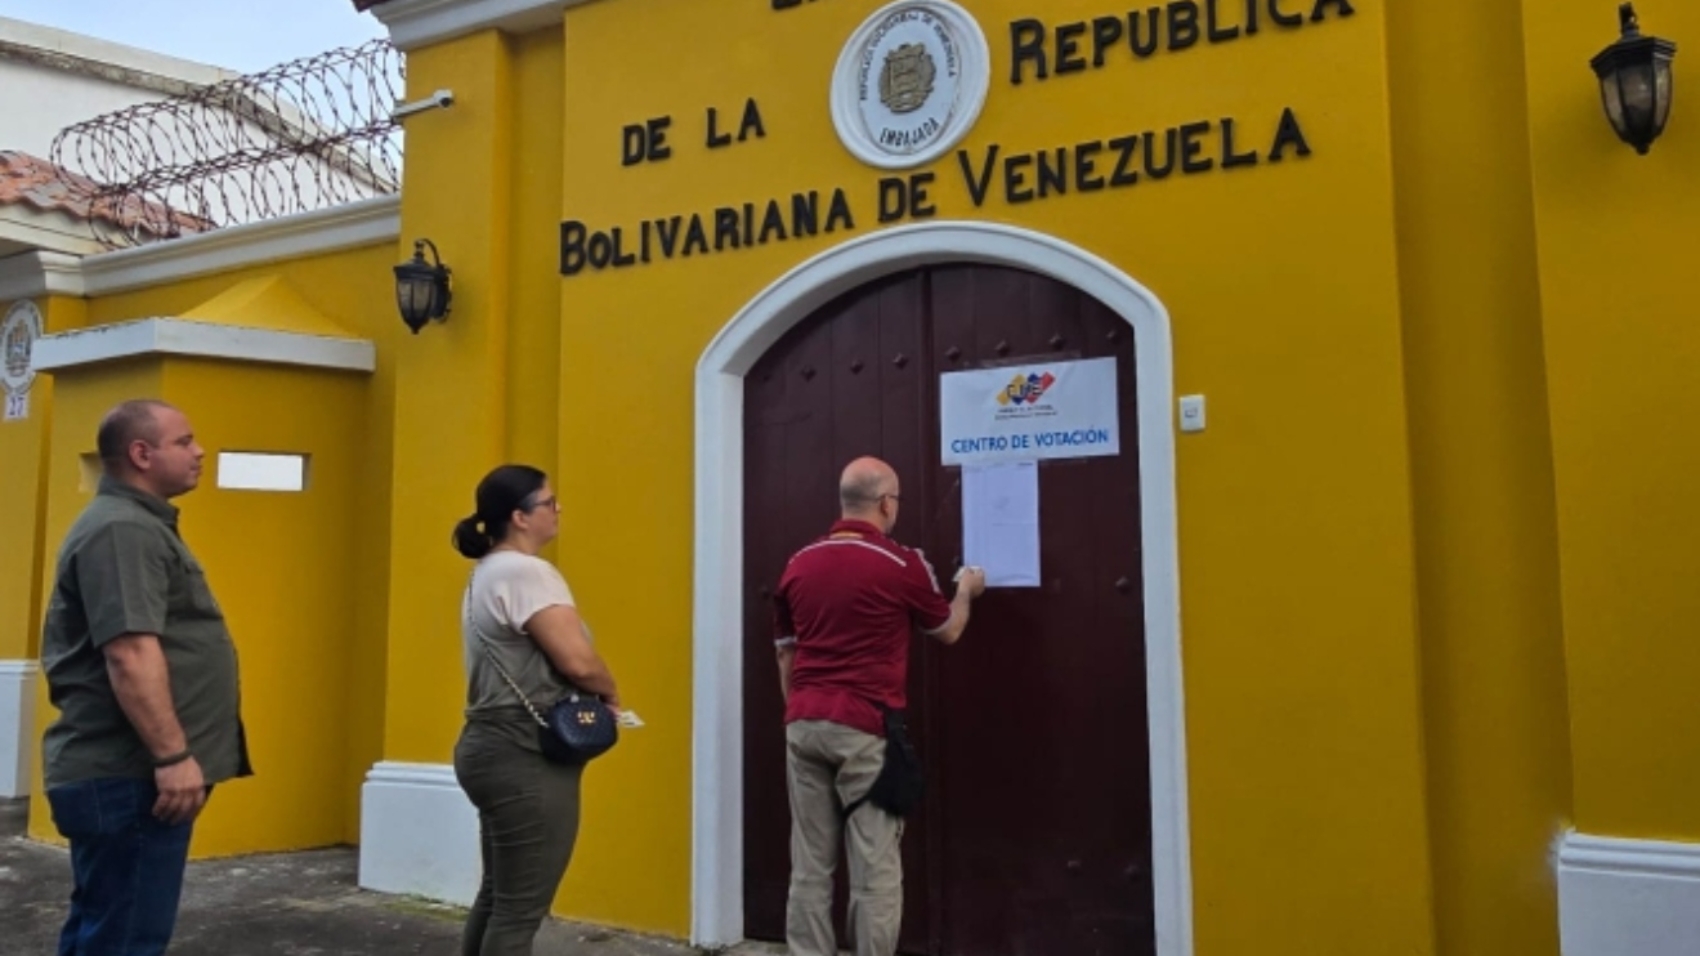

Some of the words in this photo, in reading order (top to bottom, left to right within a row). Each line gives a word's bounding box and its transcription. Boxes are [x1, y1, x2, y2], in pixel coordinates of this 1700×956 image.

[622, 115, 671, 166] DE
[706, 97, 766, 148] LA
[879, 116, 940, 147] EMBAJADA
[559, 188, 855, 276] BOLIVARIANA
[878, 172, 937, 224] DE
[957, 106, 1312, 208] VENEZUELA
[951, 437, 1008, 453] CENTRO
[1011, 435, 1031, 449] DE
[1034, 425, 1109, 447] VOTACIÓN
